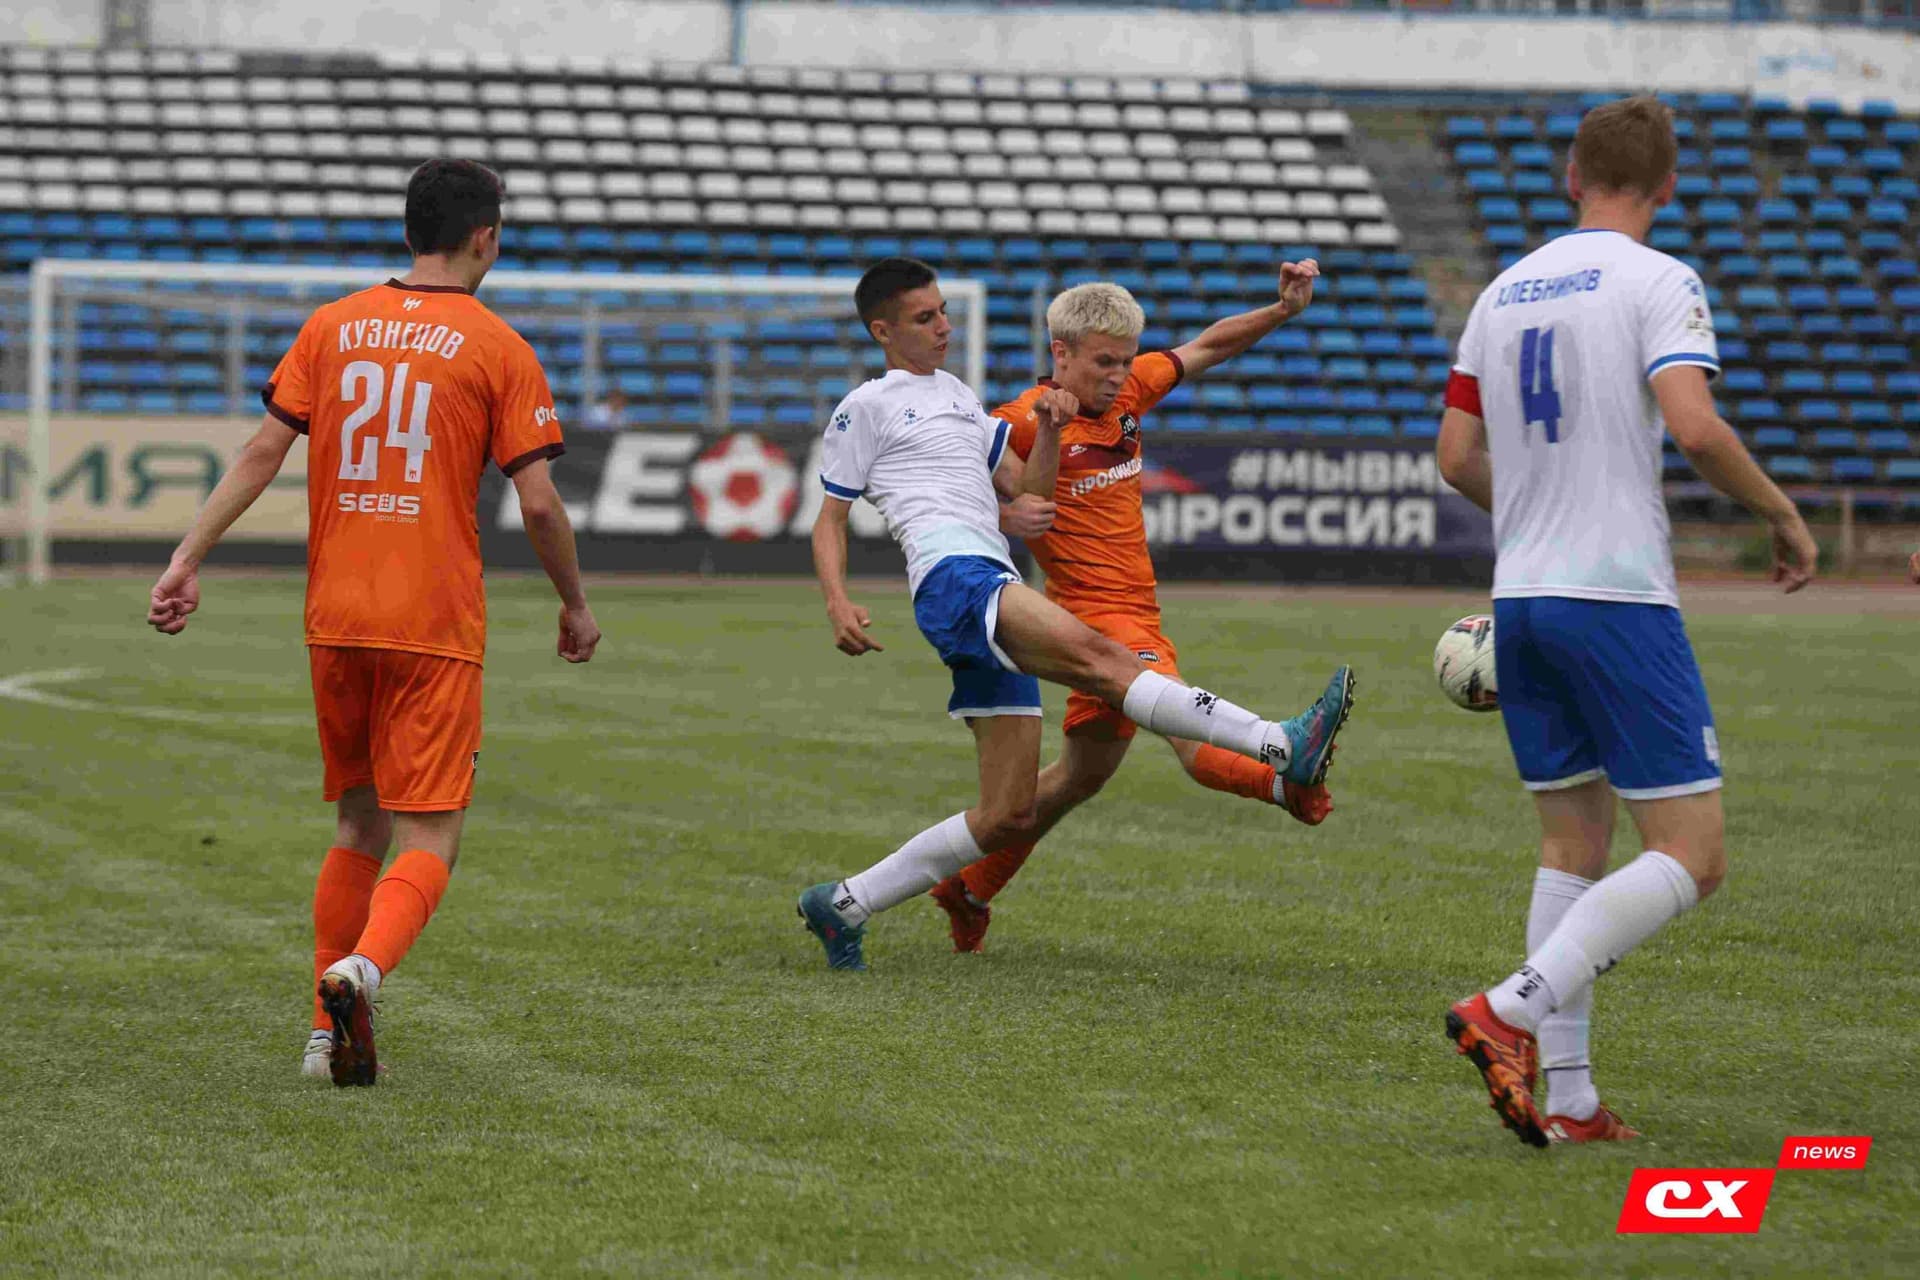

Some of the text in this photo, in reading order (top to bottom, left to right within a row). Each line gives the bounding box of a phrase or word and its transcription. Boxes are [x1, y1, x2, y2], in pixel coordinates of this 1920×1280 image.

[338, 317, 465, 360] КУЗНЕЦОВ
[338, 360, 433, 484] 24
[1519, 327, 1562, 444] 4
[338, 492, 421, 515] SEUS
